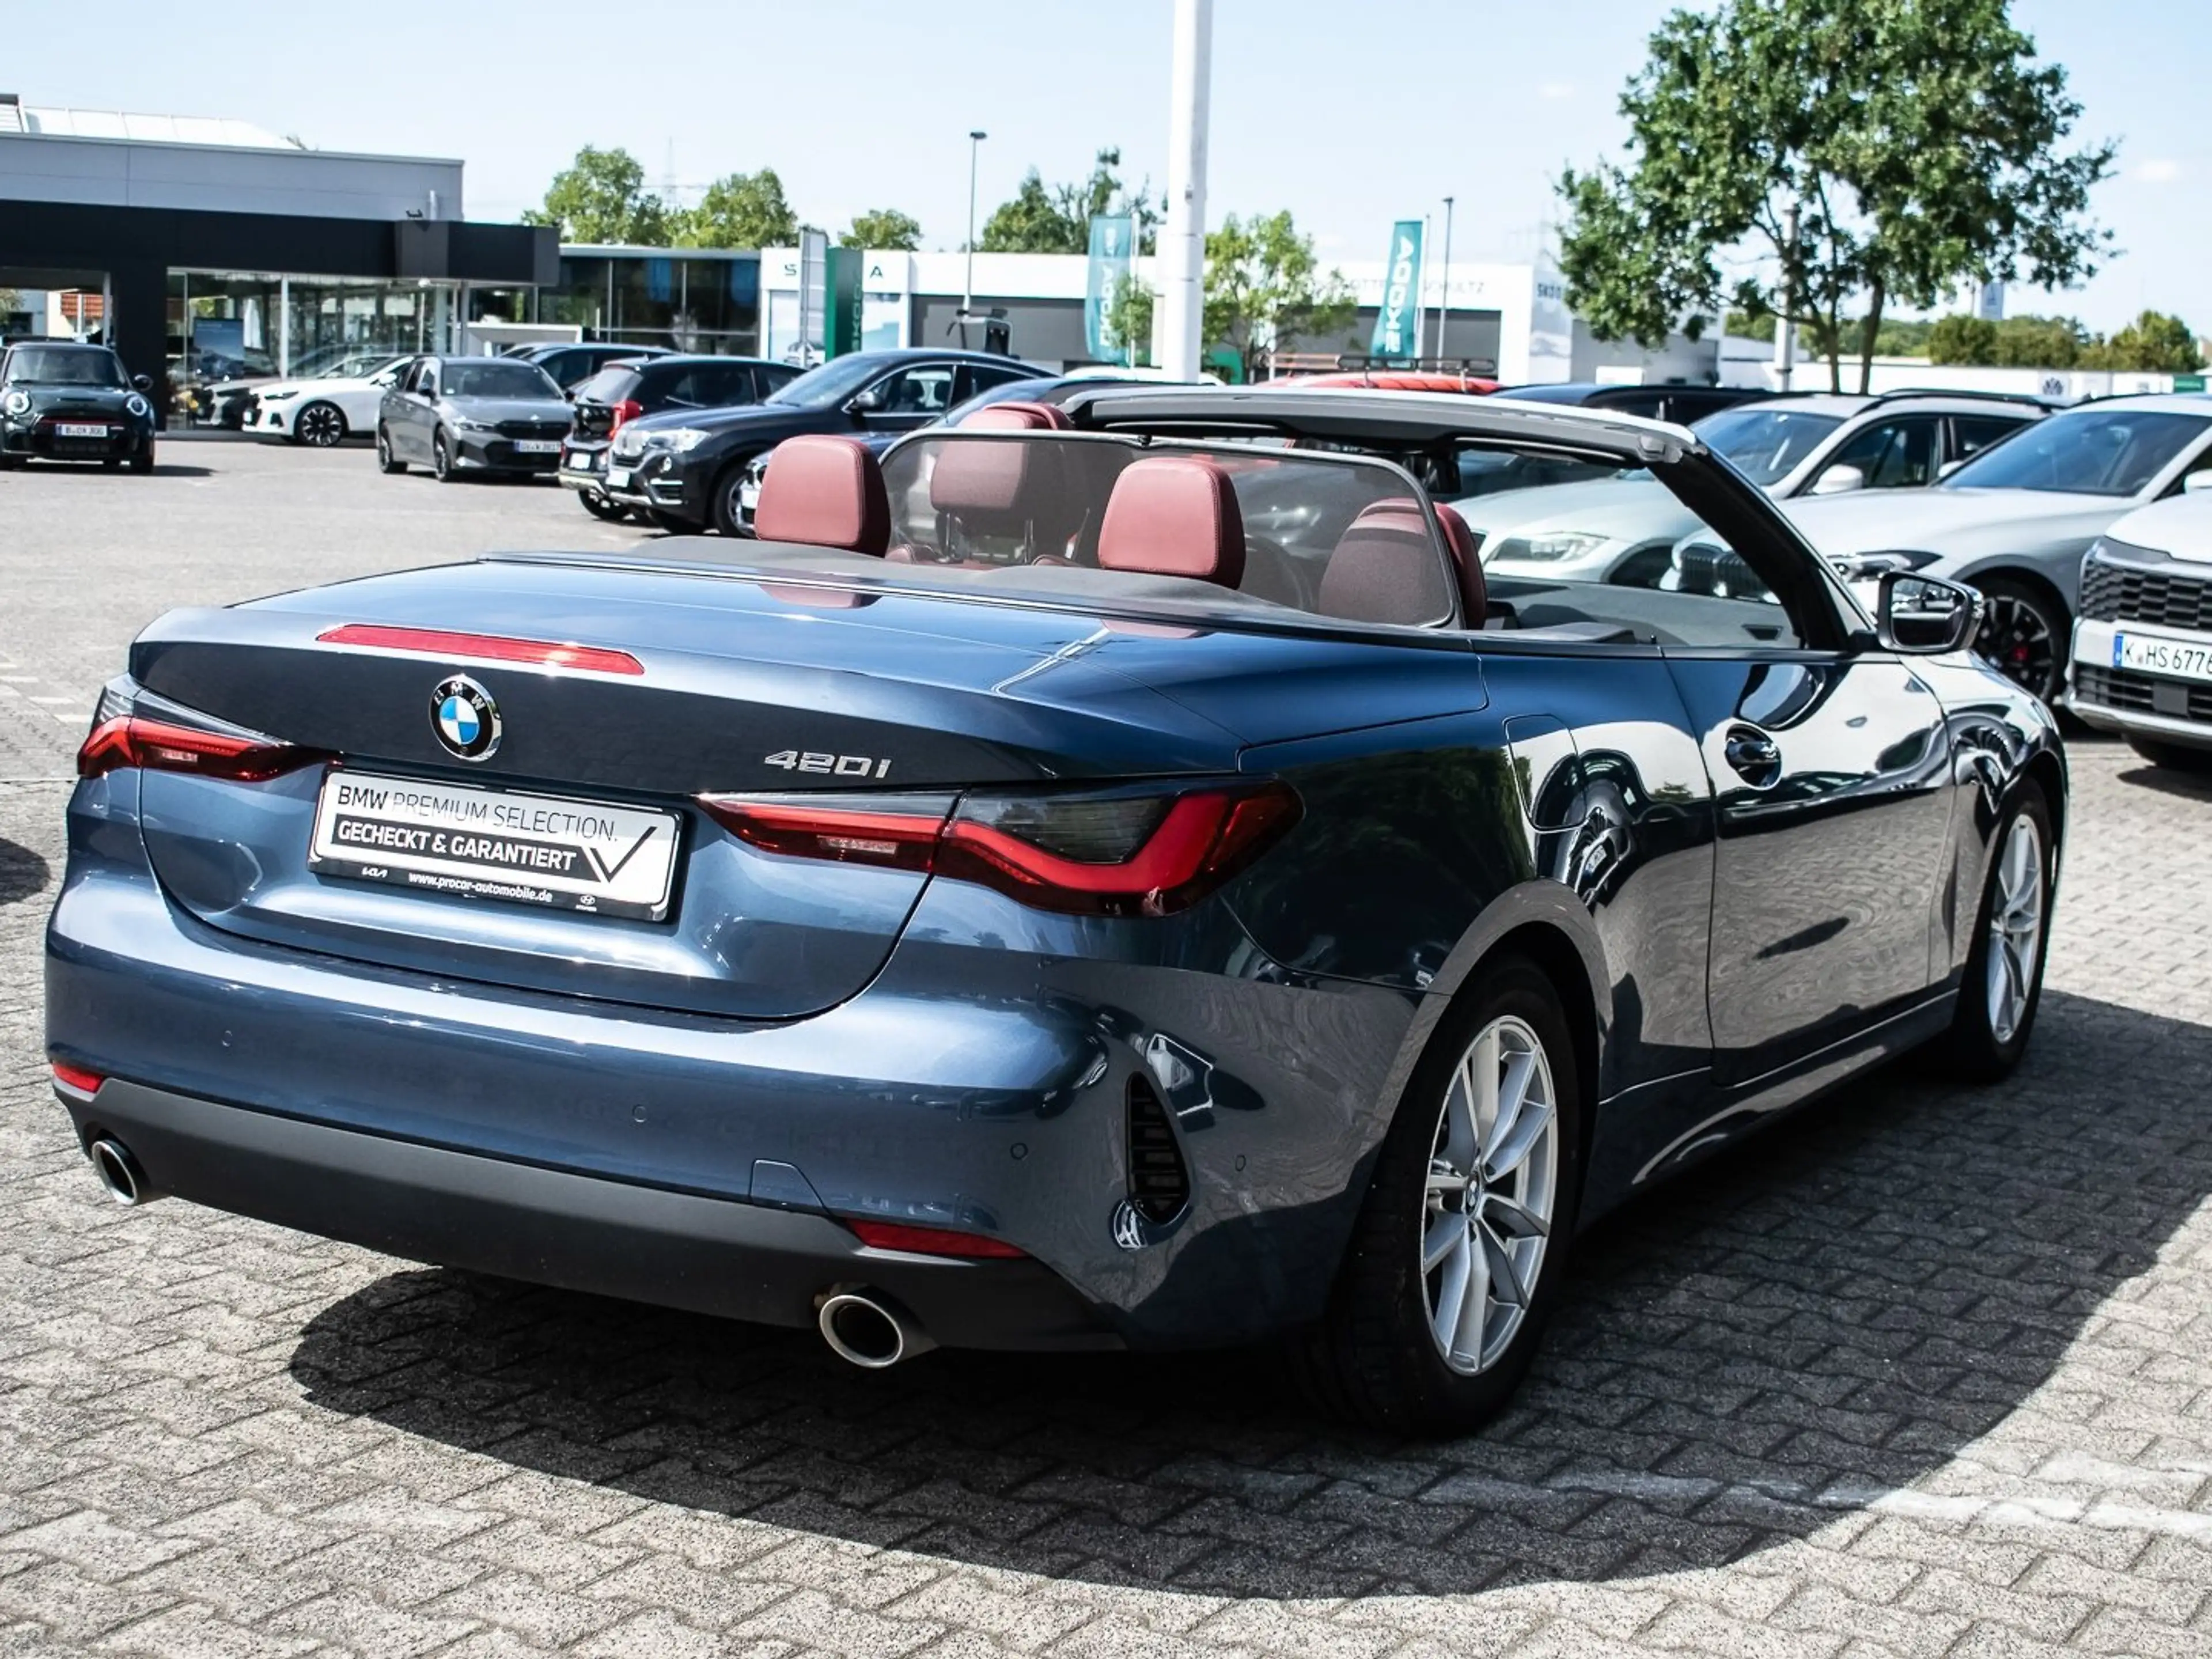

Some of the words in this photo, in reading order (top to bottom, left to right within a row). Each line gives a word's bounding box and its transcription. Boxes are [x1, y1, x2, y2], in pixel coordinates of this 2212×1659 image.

[2124, 642, 2135, 662] K
[2146, 645, 2168, 668] HS
[434, 680, 486, 710] BMW
[338, 785, 389, 810] BMW
[392, 792, 488, 824] PREMIUM
[338, 820, 431, 851] GECHECKT
[431, 833, 447, 854] &
[450, 835, 577, 871] GARANTIERT
[408, 872, 554, 903] www.procar-automobile.de
